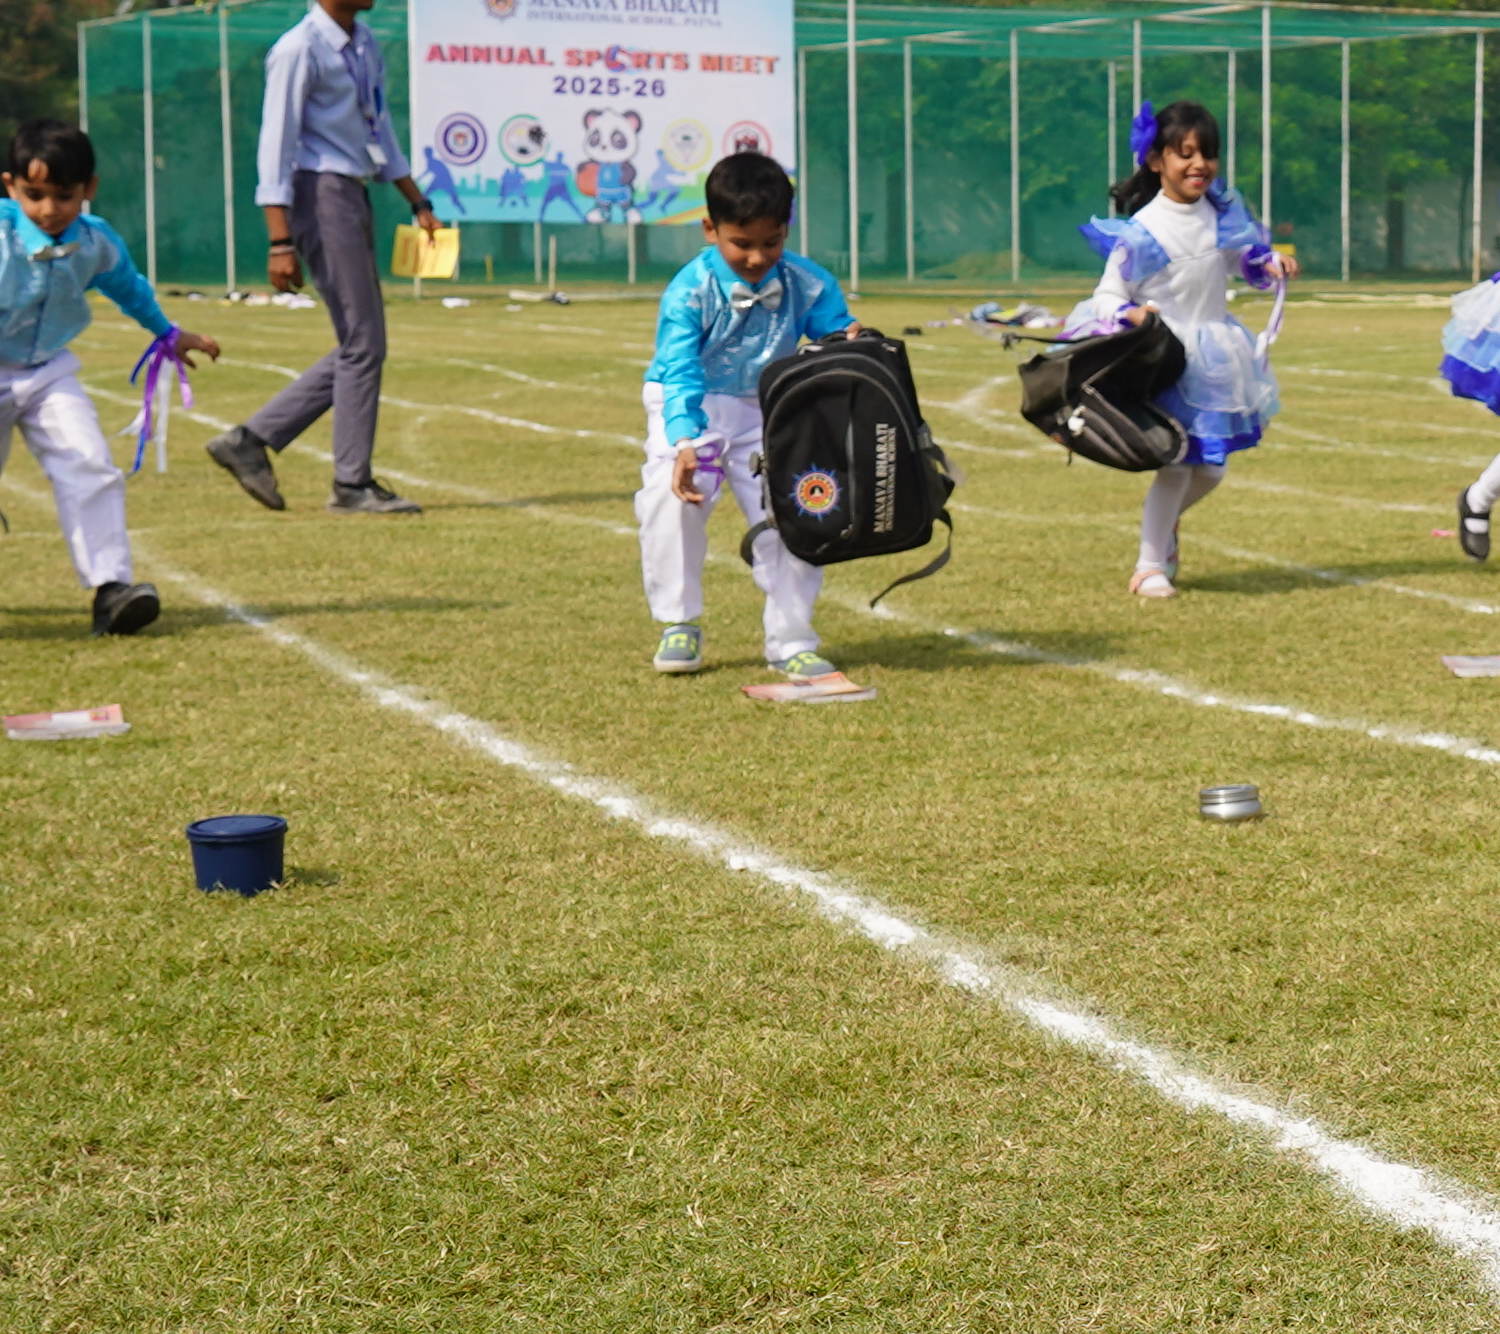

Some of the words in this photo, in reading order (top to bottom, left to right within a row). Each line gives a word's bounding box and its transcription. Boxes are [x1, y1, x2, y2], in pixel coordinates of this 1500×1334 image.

[426, 44, 553, 67] ANNUAL
[565, 45, 689, 73] SPORTS
[699, 53, 779, 74] MEET
[553, 76, 666, 98] 2025-26
